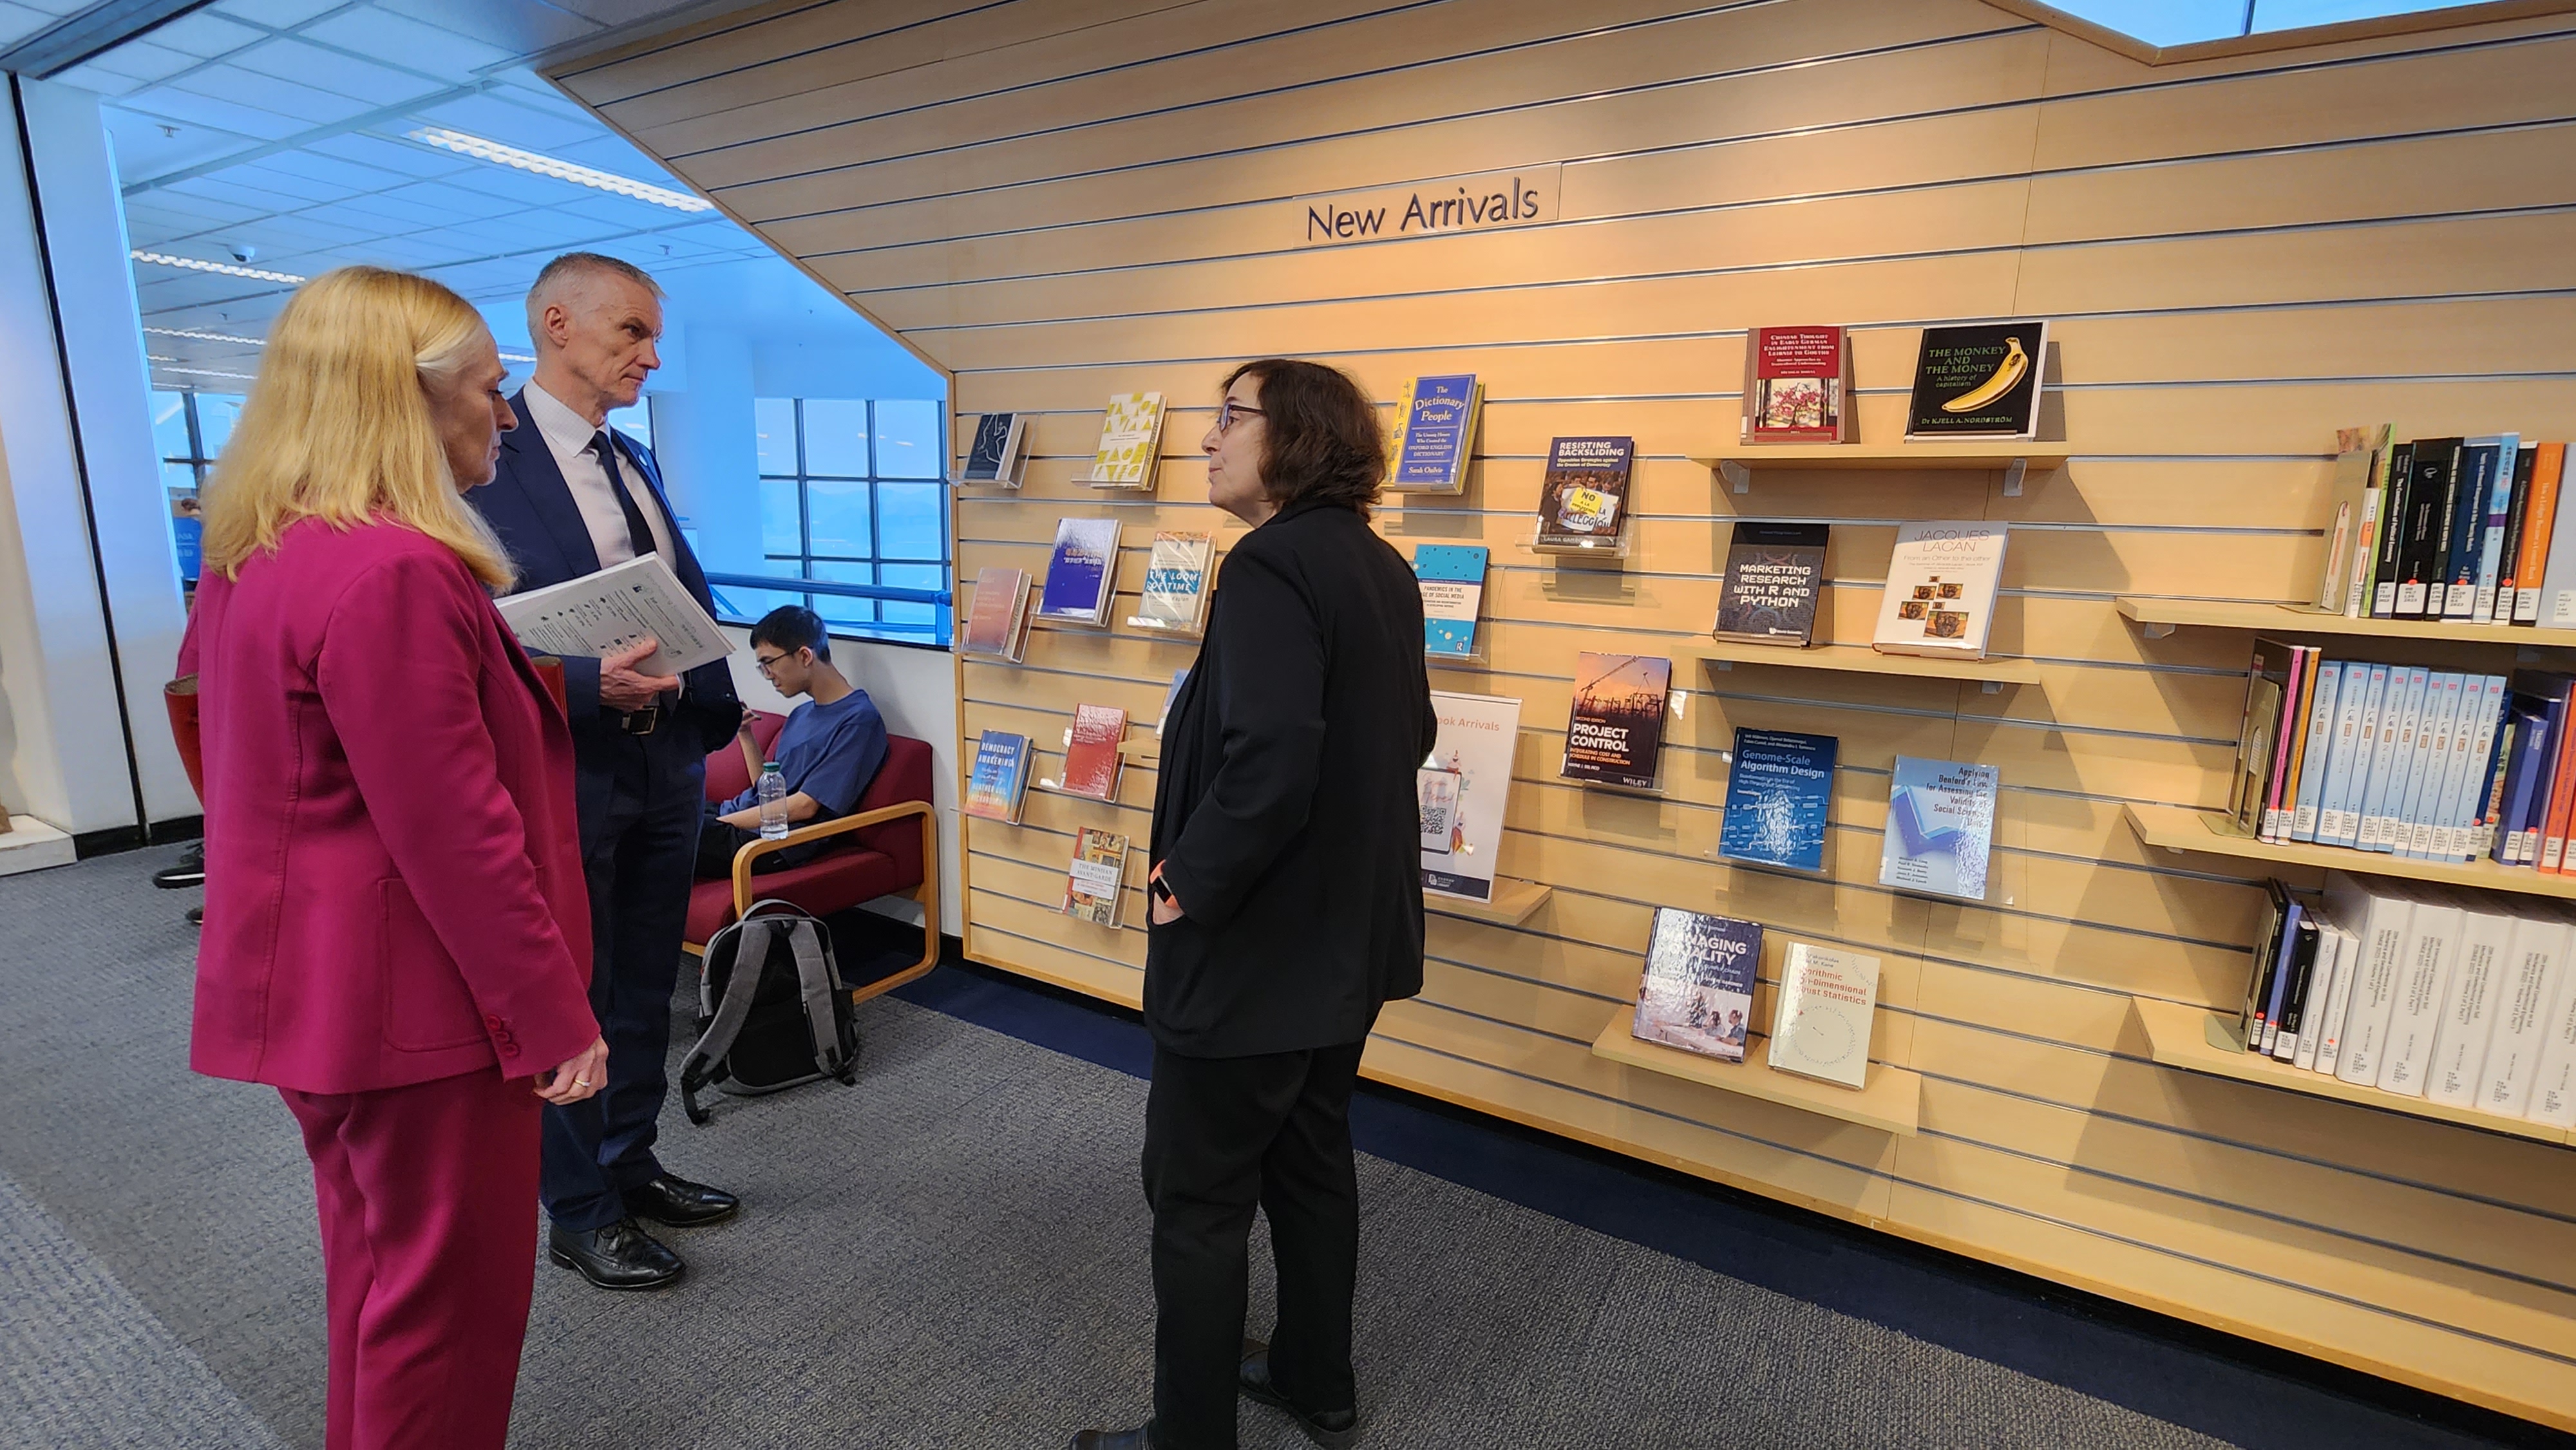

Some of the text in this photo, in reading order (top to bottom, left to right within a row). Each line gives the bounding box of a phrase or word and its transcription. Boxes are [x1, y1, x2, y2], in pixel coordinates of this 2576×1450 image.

[1307, 176, 1539, 242] New Arrivals
[1929, 346, 2005, 357] THE MONKEY
[1944, 356, 1971, 365] AND
[1926, 363, 1995, 375] THE MONEY
[1415, 396, 1464, 411] Dictionary
[1421, 410, 1452, 422] People
[1558, 448, 1624, 457] BACKSLIDING
[1581, 492, 1596, 502] NO
[1915, 530, 1990, 541] JACQUES
[1923, 541, 1976, 552] LACAN
[1150, 570, 1198, 581] THE LOOM
[1740, 564, 1811, 575] MARKETING
[1741, 574, 1806, 585] RESEARCH
[1734, 585, 1810, 597] WITH R AND
[1740, 596, 1799, 608] PYTHON
[1458, 717, 1500, 731] Arrivals
[1573, 724, 1629, 739] PROJECT
[981, 742, 1015, 755] DEMOCRACY
[1571, 735, 1629, 752] CONTROL
[978, 755, 1014, 768] AWAKENING
[1597, 757, 1630, 765] CONSTRUCTION
[1743, 749, 1810, 765] Genome-Scale
[1741, 760, 1824, 780] Algorithm Design
[1958, 767, 1989, 779] Applying
[1623, 777, 1647, 786] WILEY
[1938, 775, 1971, 786] Benford's
[1926, 783, 1936, 791] for
[1938, 784, 1973, 797] Assessing
[1934, 804, 1955, 814] Social
[1823, 990, 1866, 1006] Statistics
